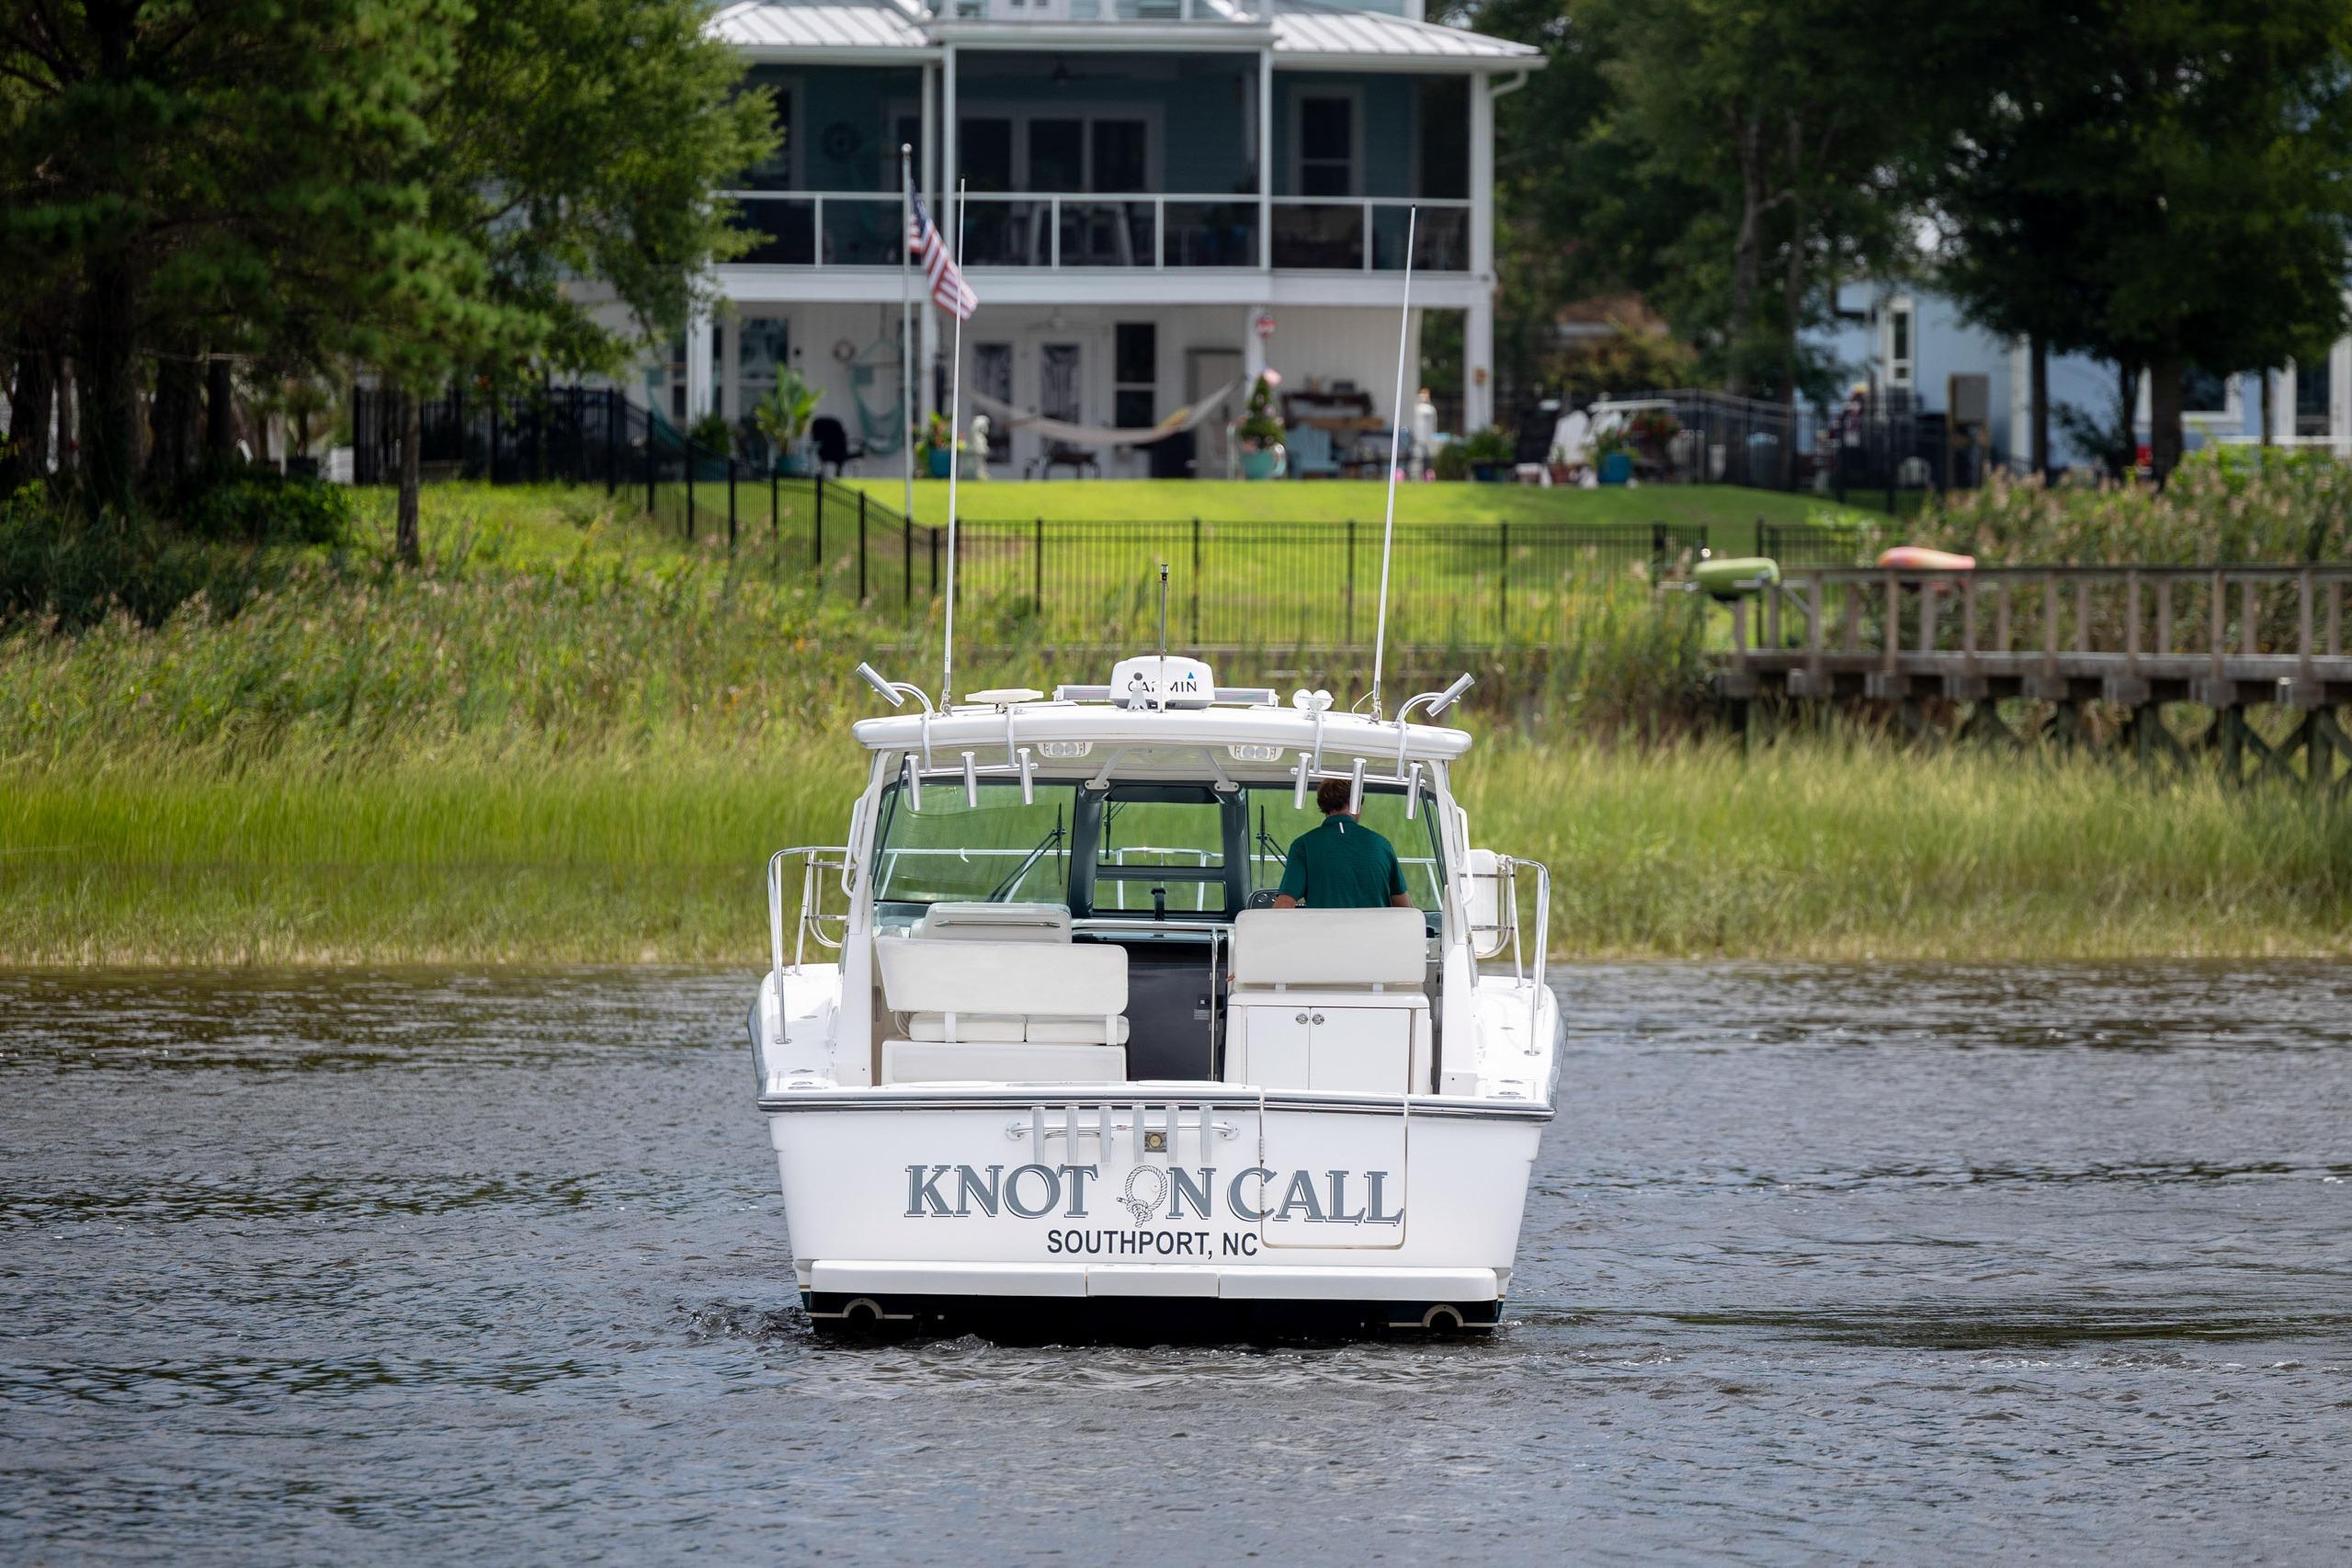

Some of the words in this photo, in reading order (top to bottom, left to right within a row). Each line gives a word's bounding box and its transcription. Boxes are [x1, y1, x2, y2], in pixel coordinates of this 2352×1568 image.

[1128, 680, 1197, 692] AMIN
[903, 1164, 1098, 1219] KNOT
[1226, 1166, 1403, 1227] CALL
[1046, 1230, 1213, 1260] SOUTHPORT,
[1221, 1232, 1257, 1256] NC
